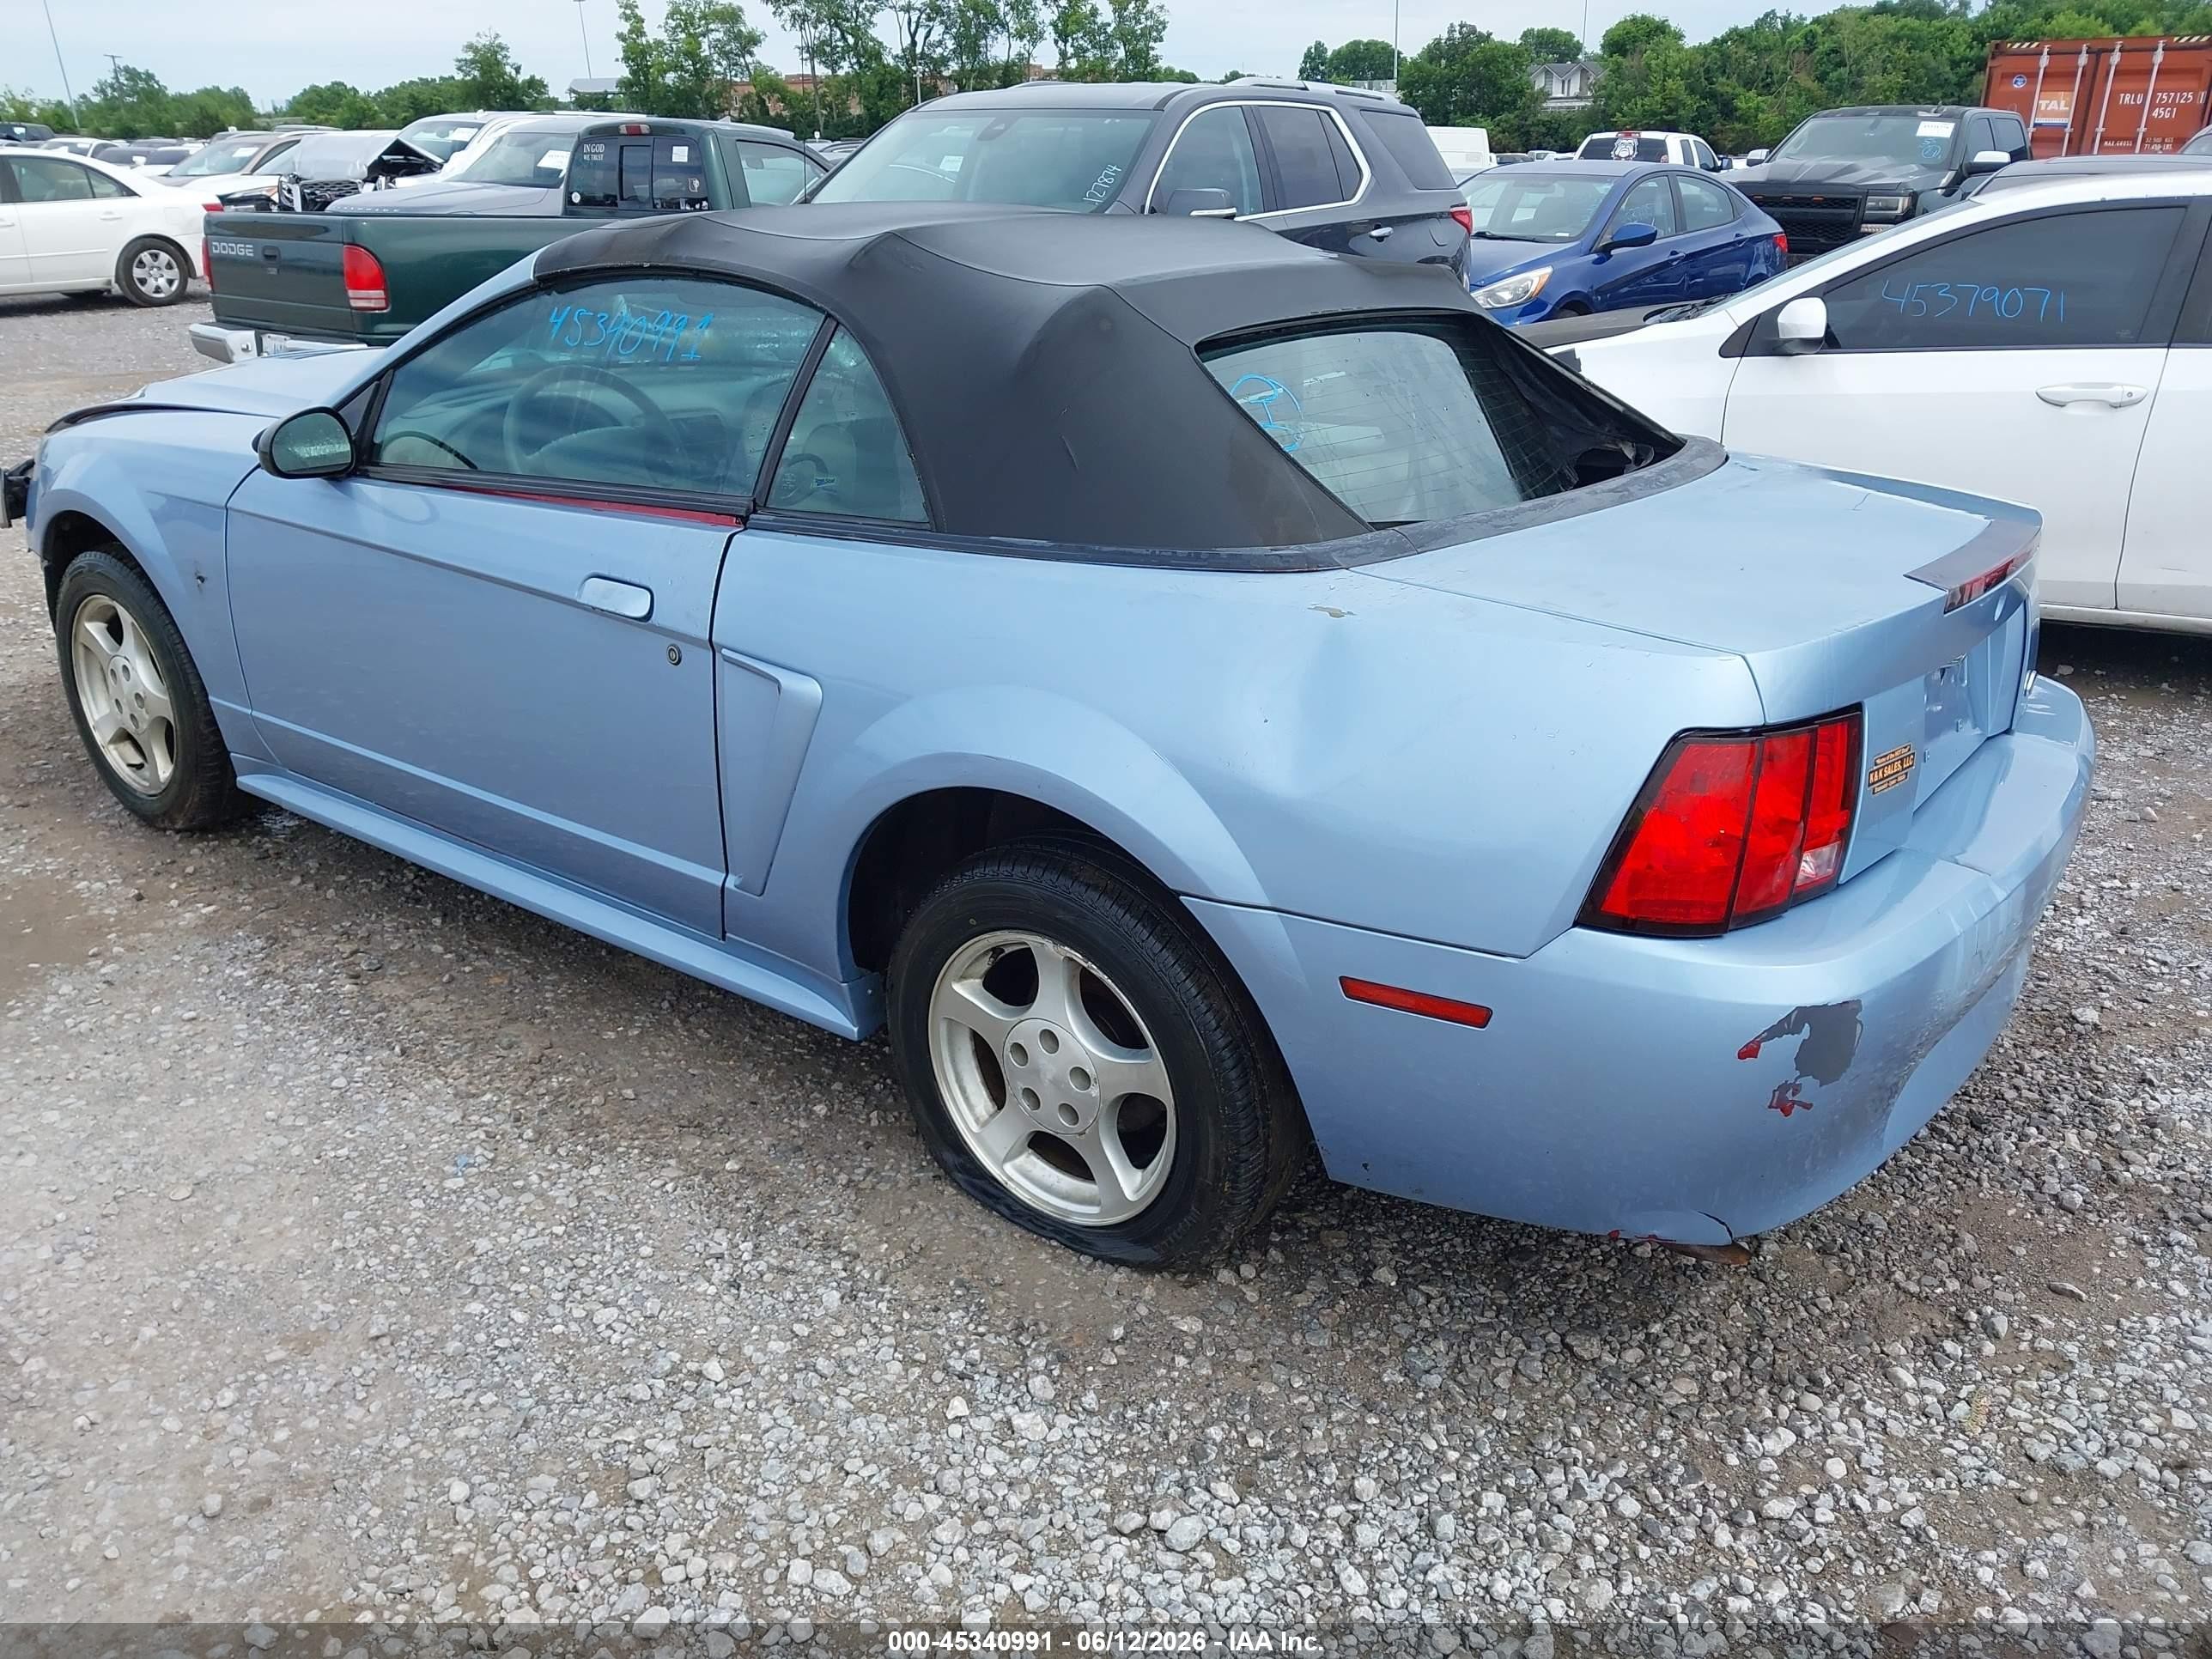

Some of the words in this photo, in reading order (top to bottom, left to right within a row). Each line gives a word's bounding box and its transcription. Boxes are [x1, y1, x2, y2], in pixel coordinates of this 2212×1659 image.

[2119, 93, 2144, 104] TRLU
[2156, 92, 2194, 103] 757125
[2039, 100, 2069, 110] TAL
[2152, 107, 2177, 118] 45G1
[583, 143, 591, 153] IN
[591, 143, 605, 153] GOD
[212, 241, 254, 256] DODGE
[1881, 280, 2064, 323] 45379071
[1903, 754, 1914, 769] LLC
